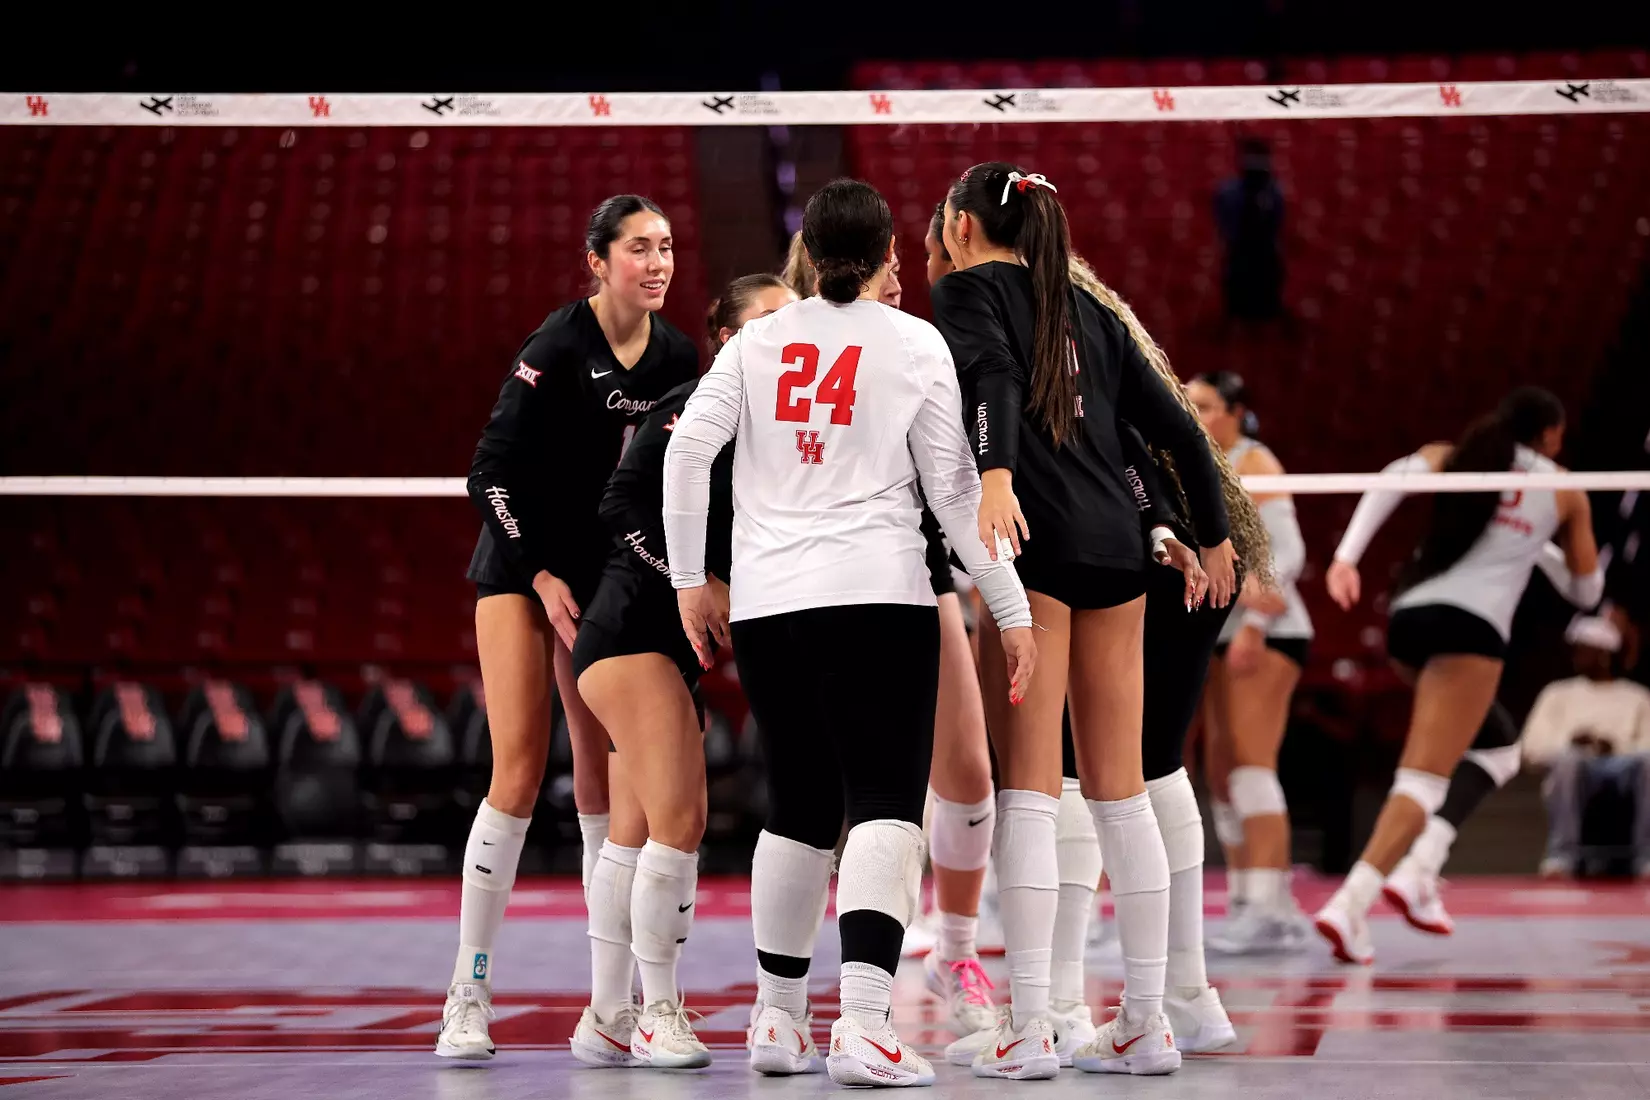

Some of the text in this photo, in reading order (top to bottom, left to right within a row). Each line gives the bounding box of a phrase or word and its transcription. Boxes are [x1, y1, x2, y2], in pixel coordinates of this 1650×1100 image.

[606, 389, 658, 416] Cougar
[775, 342, 863, 426] 24
[796, 430, 825, 465] UH
[977, 402, 989, 456] Houston
[485, 486, 521, 538] Houston
[1124, 465, 1152, 512] Housto
